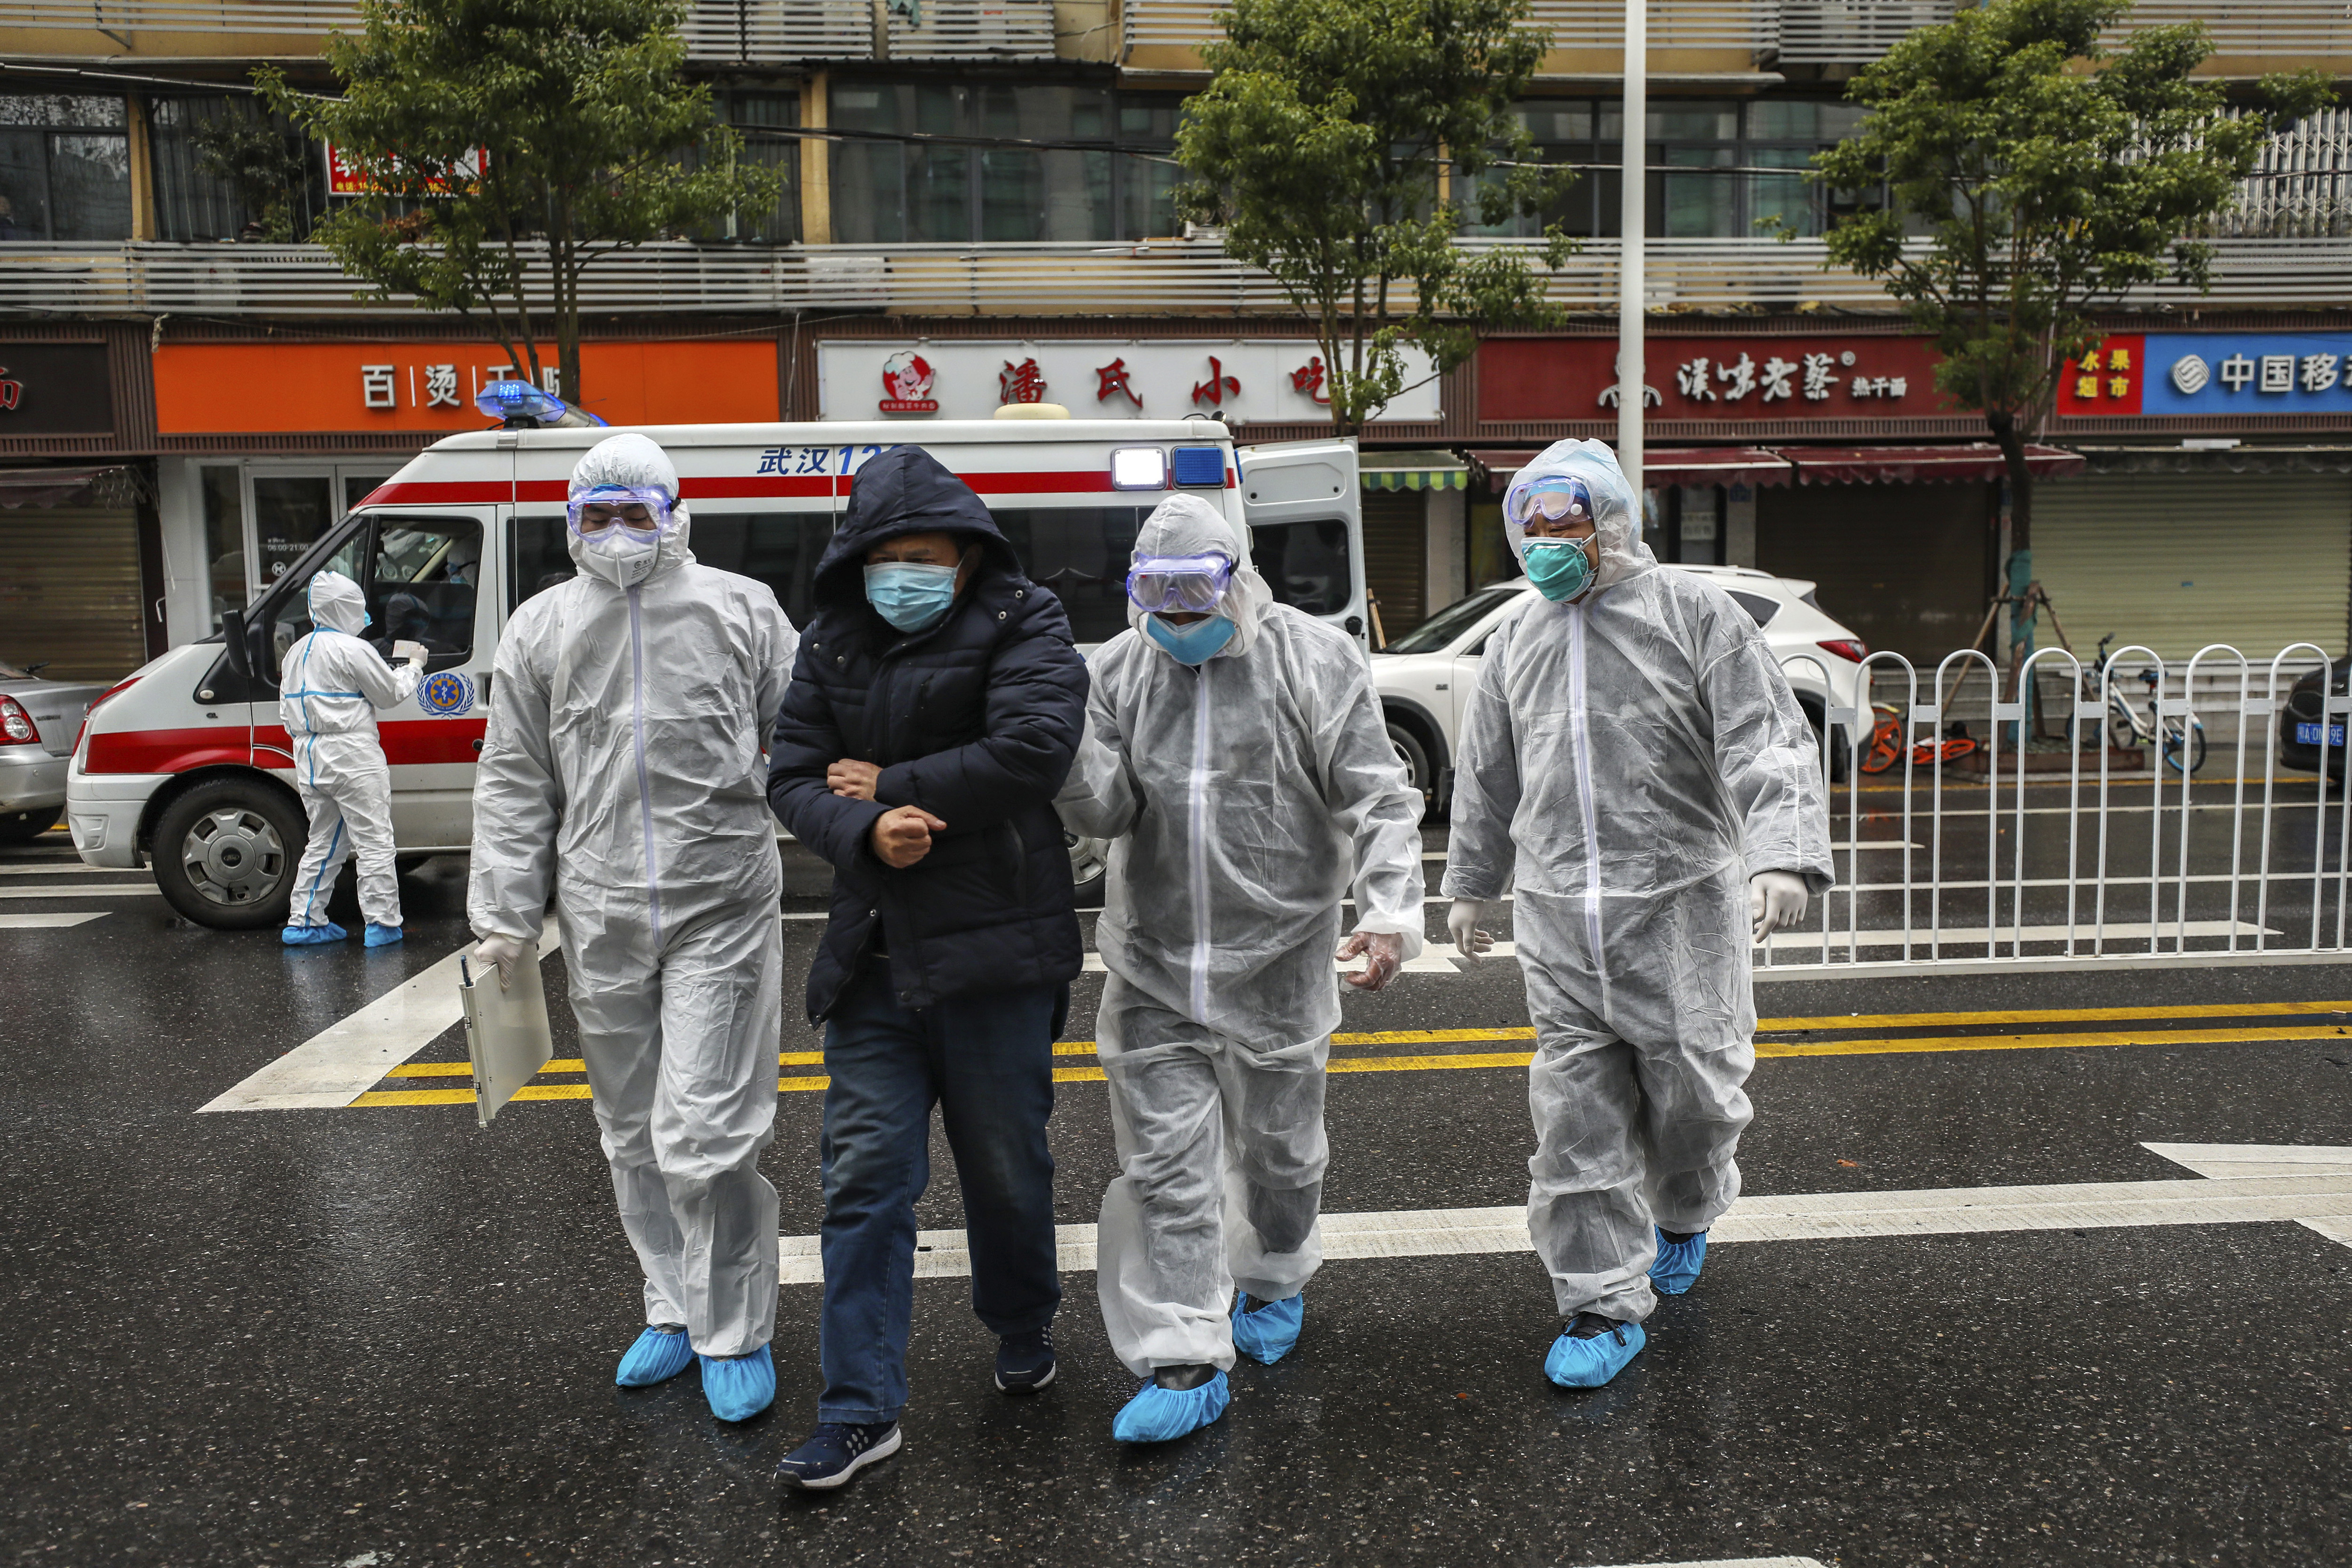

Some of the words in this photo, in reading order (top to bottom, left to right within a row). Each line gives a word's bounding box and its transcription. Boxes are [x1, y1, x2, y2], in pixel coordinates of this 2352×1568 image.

[2077, 349, 2130, 372] 水果
[2221, 353, 2352, 392] 中国移
[999, 356, 1331, 408] 潘氏小吃
[1852, 377, 1907, 398] 热干面
[2075, 376, 2130, 398] 超市
[757, 447, 830, 475] 武汉
[839, 445, 902, 475] 12
